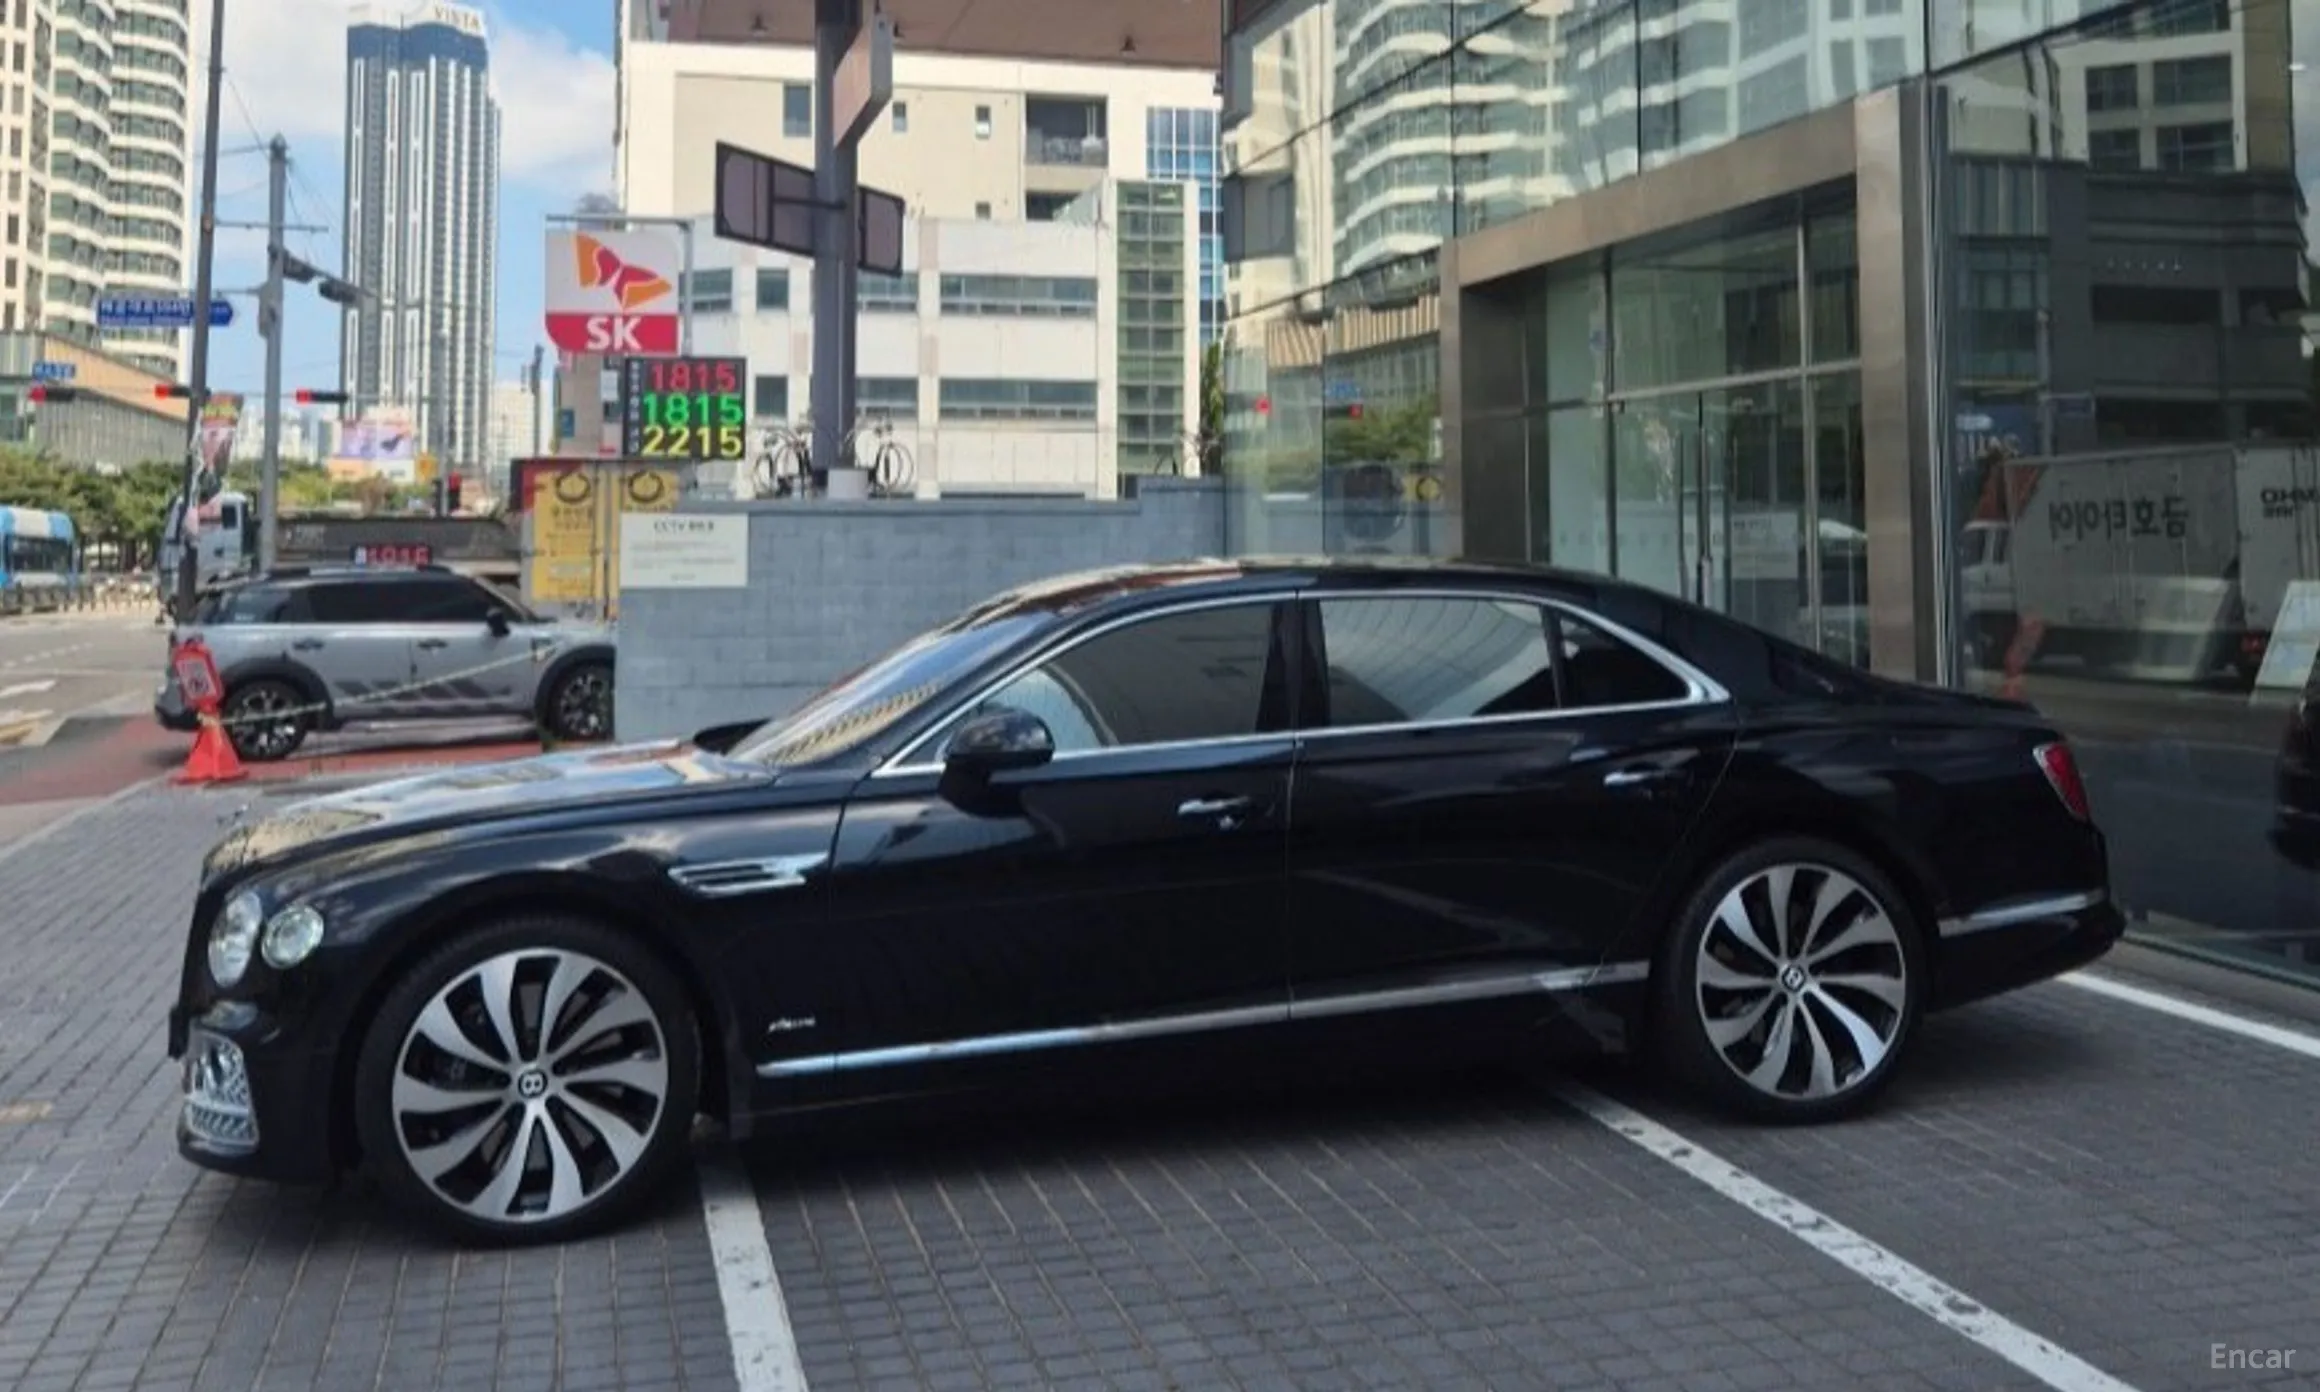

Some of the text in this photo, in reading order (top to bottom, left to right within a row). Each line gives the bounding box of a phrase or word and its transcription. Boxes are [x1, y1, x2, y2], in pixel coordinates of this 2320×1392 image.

[586, 315, 642, 351] SK
[651, 360, 736, 392] 1815
[642, 391, 744, 426] 1815
[641, 424, 743, 458] 2215
